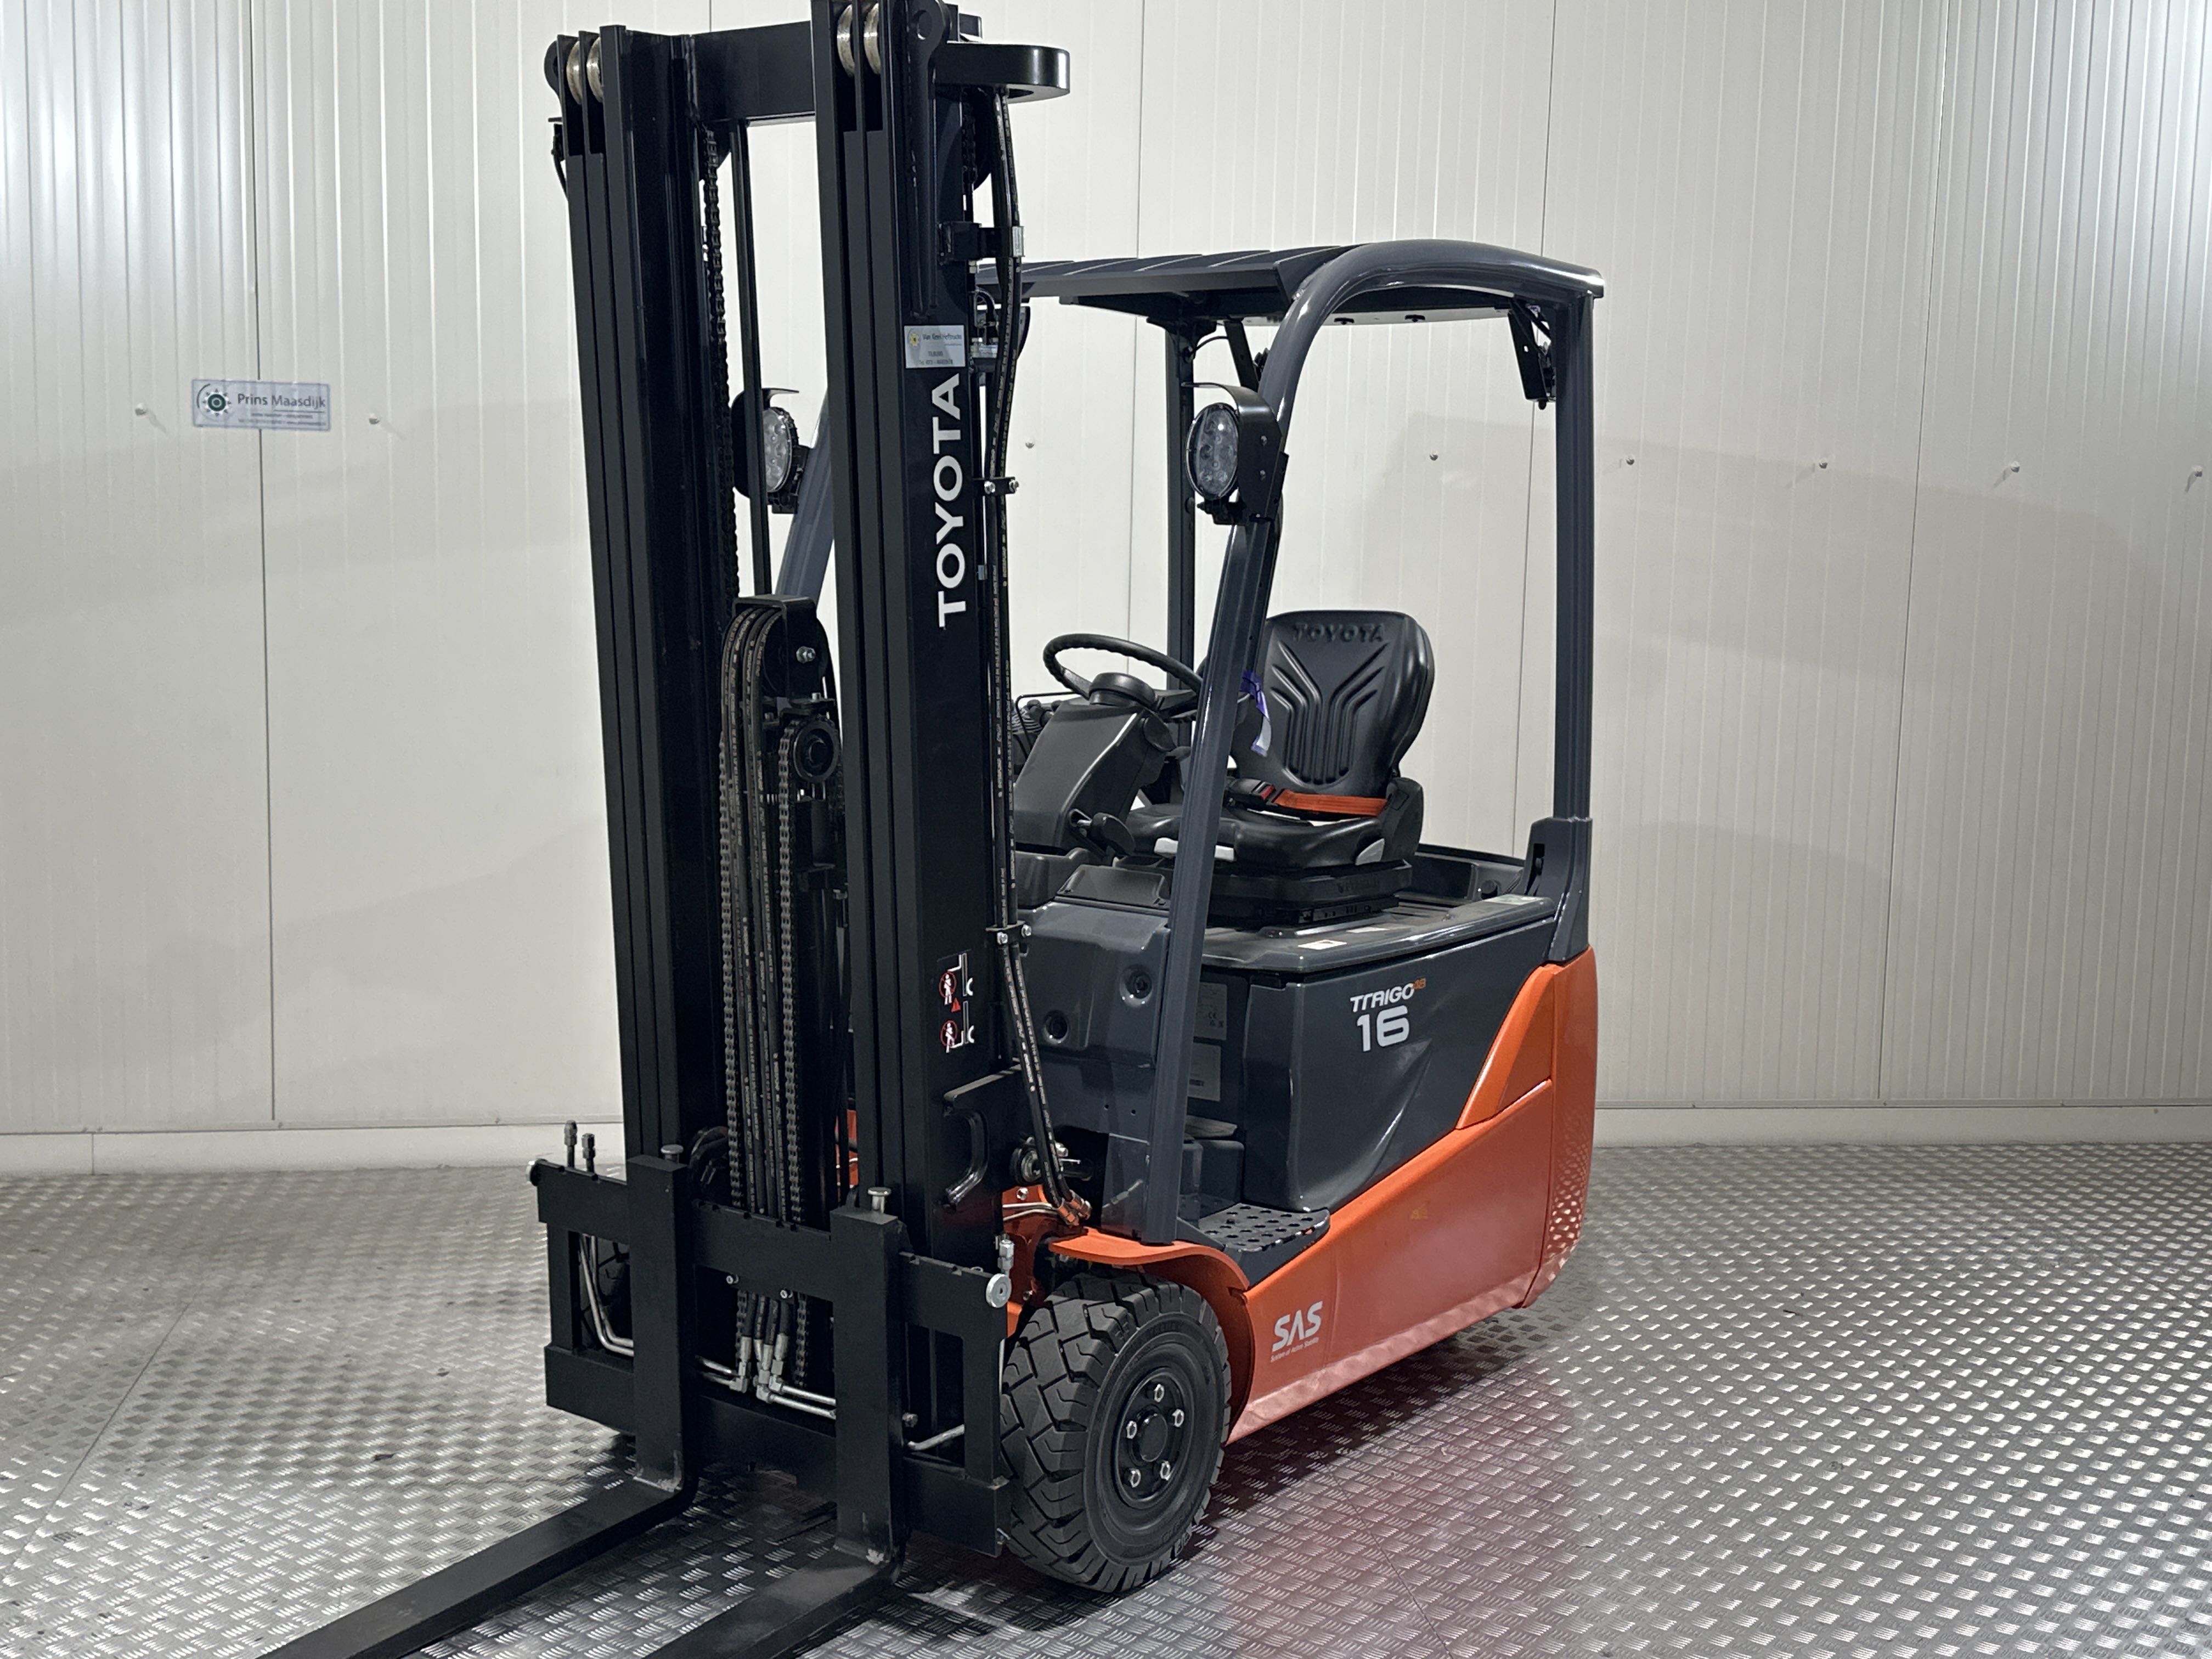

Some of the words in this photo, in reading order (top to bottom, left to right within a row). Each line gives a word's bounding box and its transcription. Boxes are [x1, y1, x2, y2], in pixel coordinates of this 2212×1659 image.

[238, 393, 268, 405] Prins
[272, 394, 326, 409] Maasdijk
[932, 373, 967, 628] TOYOTA
[1293, 622, 1384, 642] TOYOTA
[1357, 1005, 1410, 1052] 16
[1272, 1300, 1323, 1352] SAS
